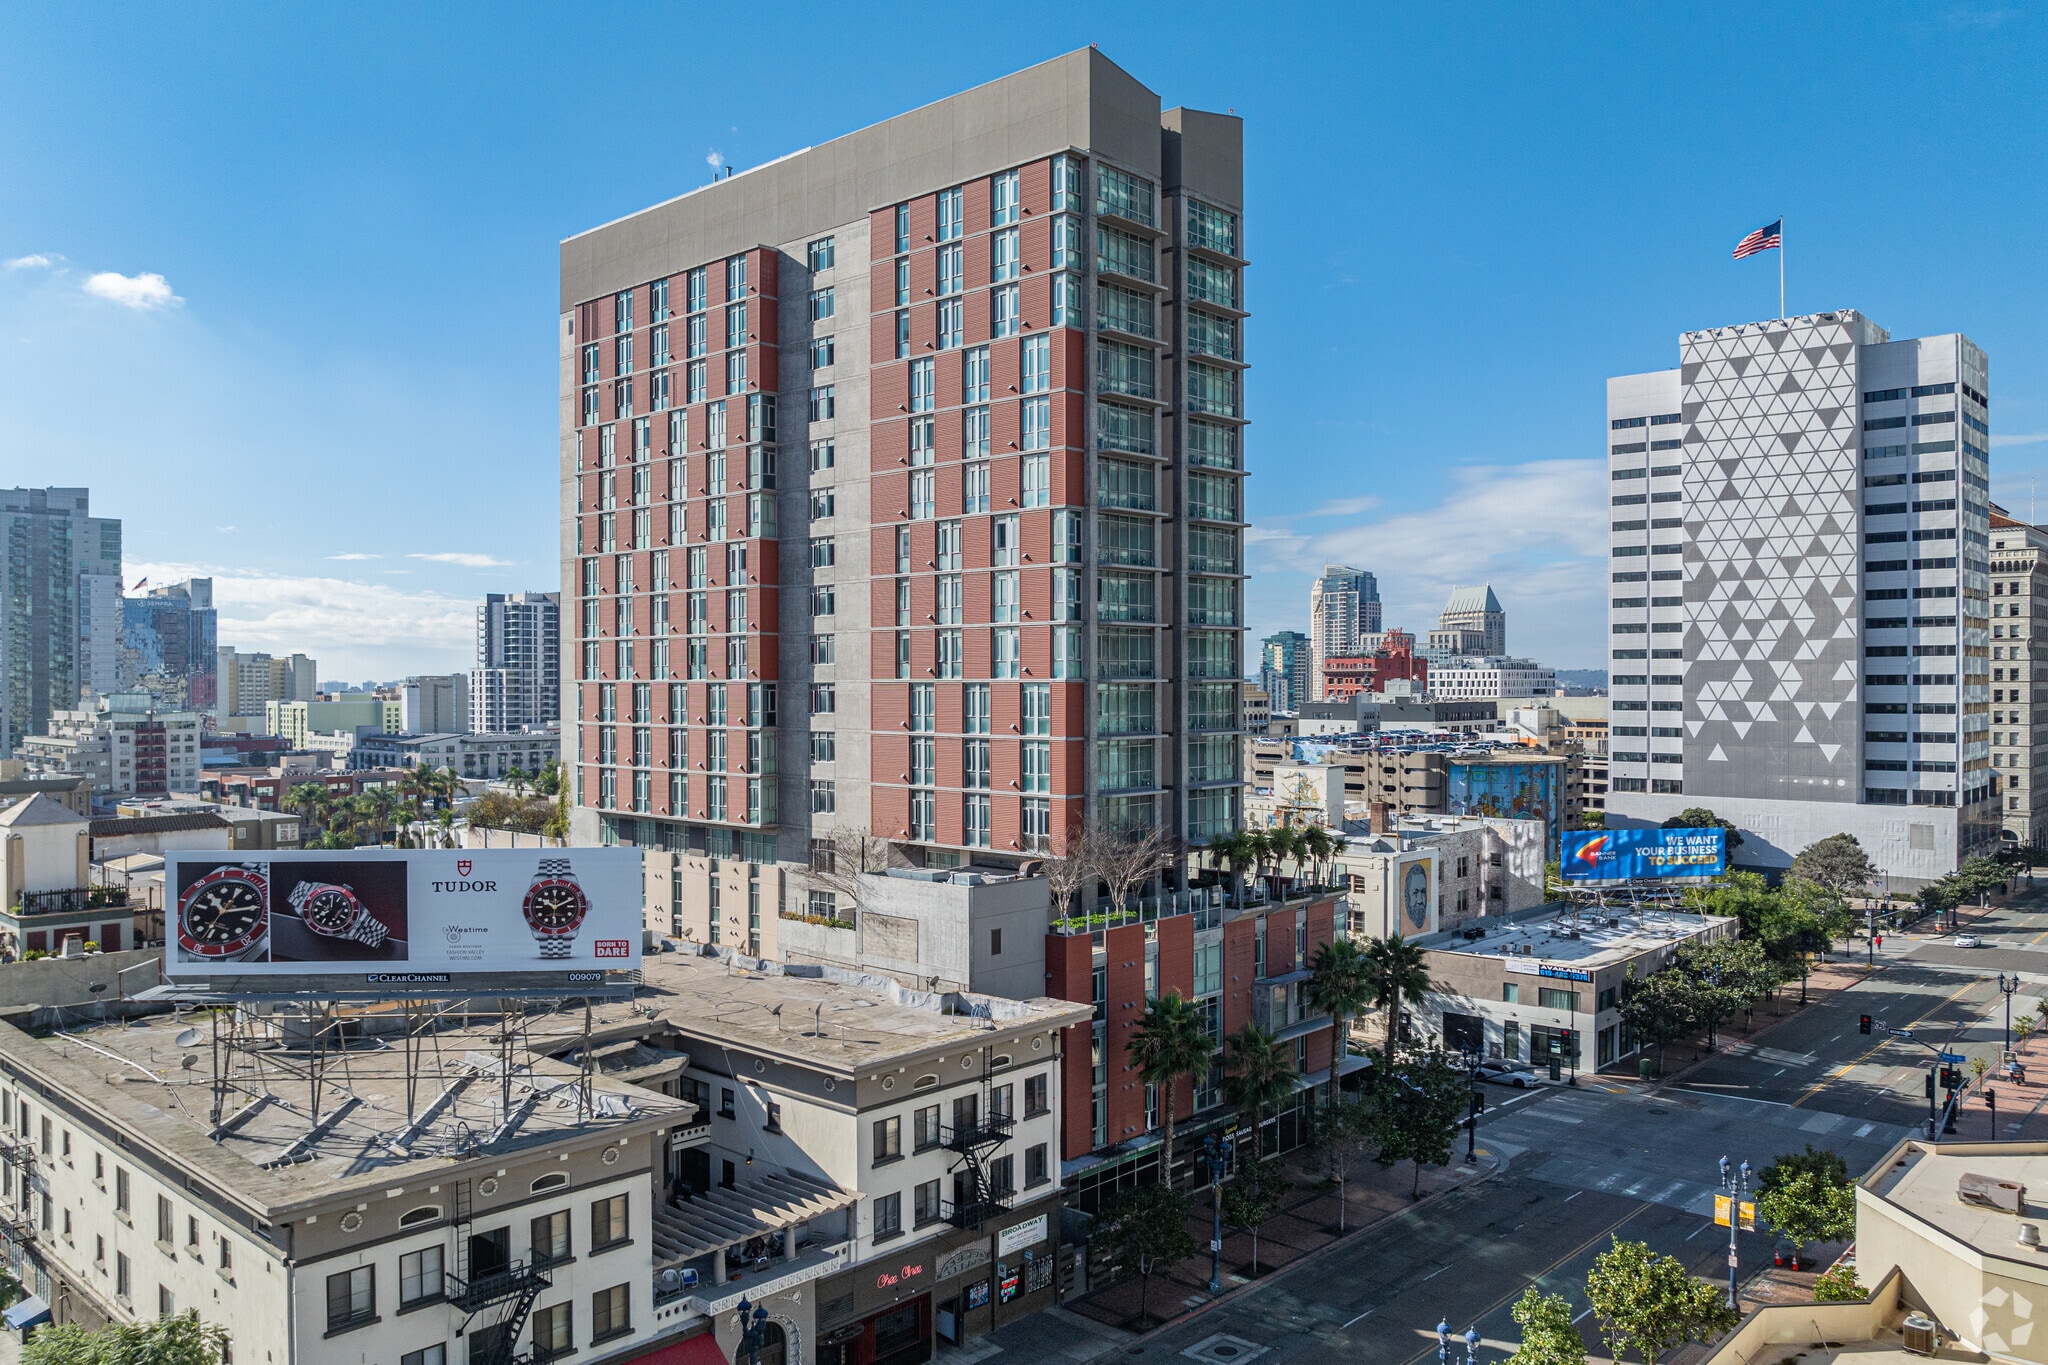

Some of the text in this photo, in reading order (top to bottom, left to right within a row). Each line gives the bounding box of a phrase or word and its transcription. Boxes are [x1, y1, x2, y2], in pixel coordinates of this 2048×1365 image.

[1666, 835, 1718, 846] WE WANT
[1635, 846, 1718, 857] YOUR BUSINESS
[1649, 855, 1718, 866] TO SUCCEED
[432, 881, 497, 892] TUDOR
[597, 947, 627, 956] DARE
[1540, 965, 1588, 975] AVAILABLE
[569, 973, 601, 981] 009079
[1001, 1216, 1044, 1237] BROADWAY
